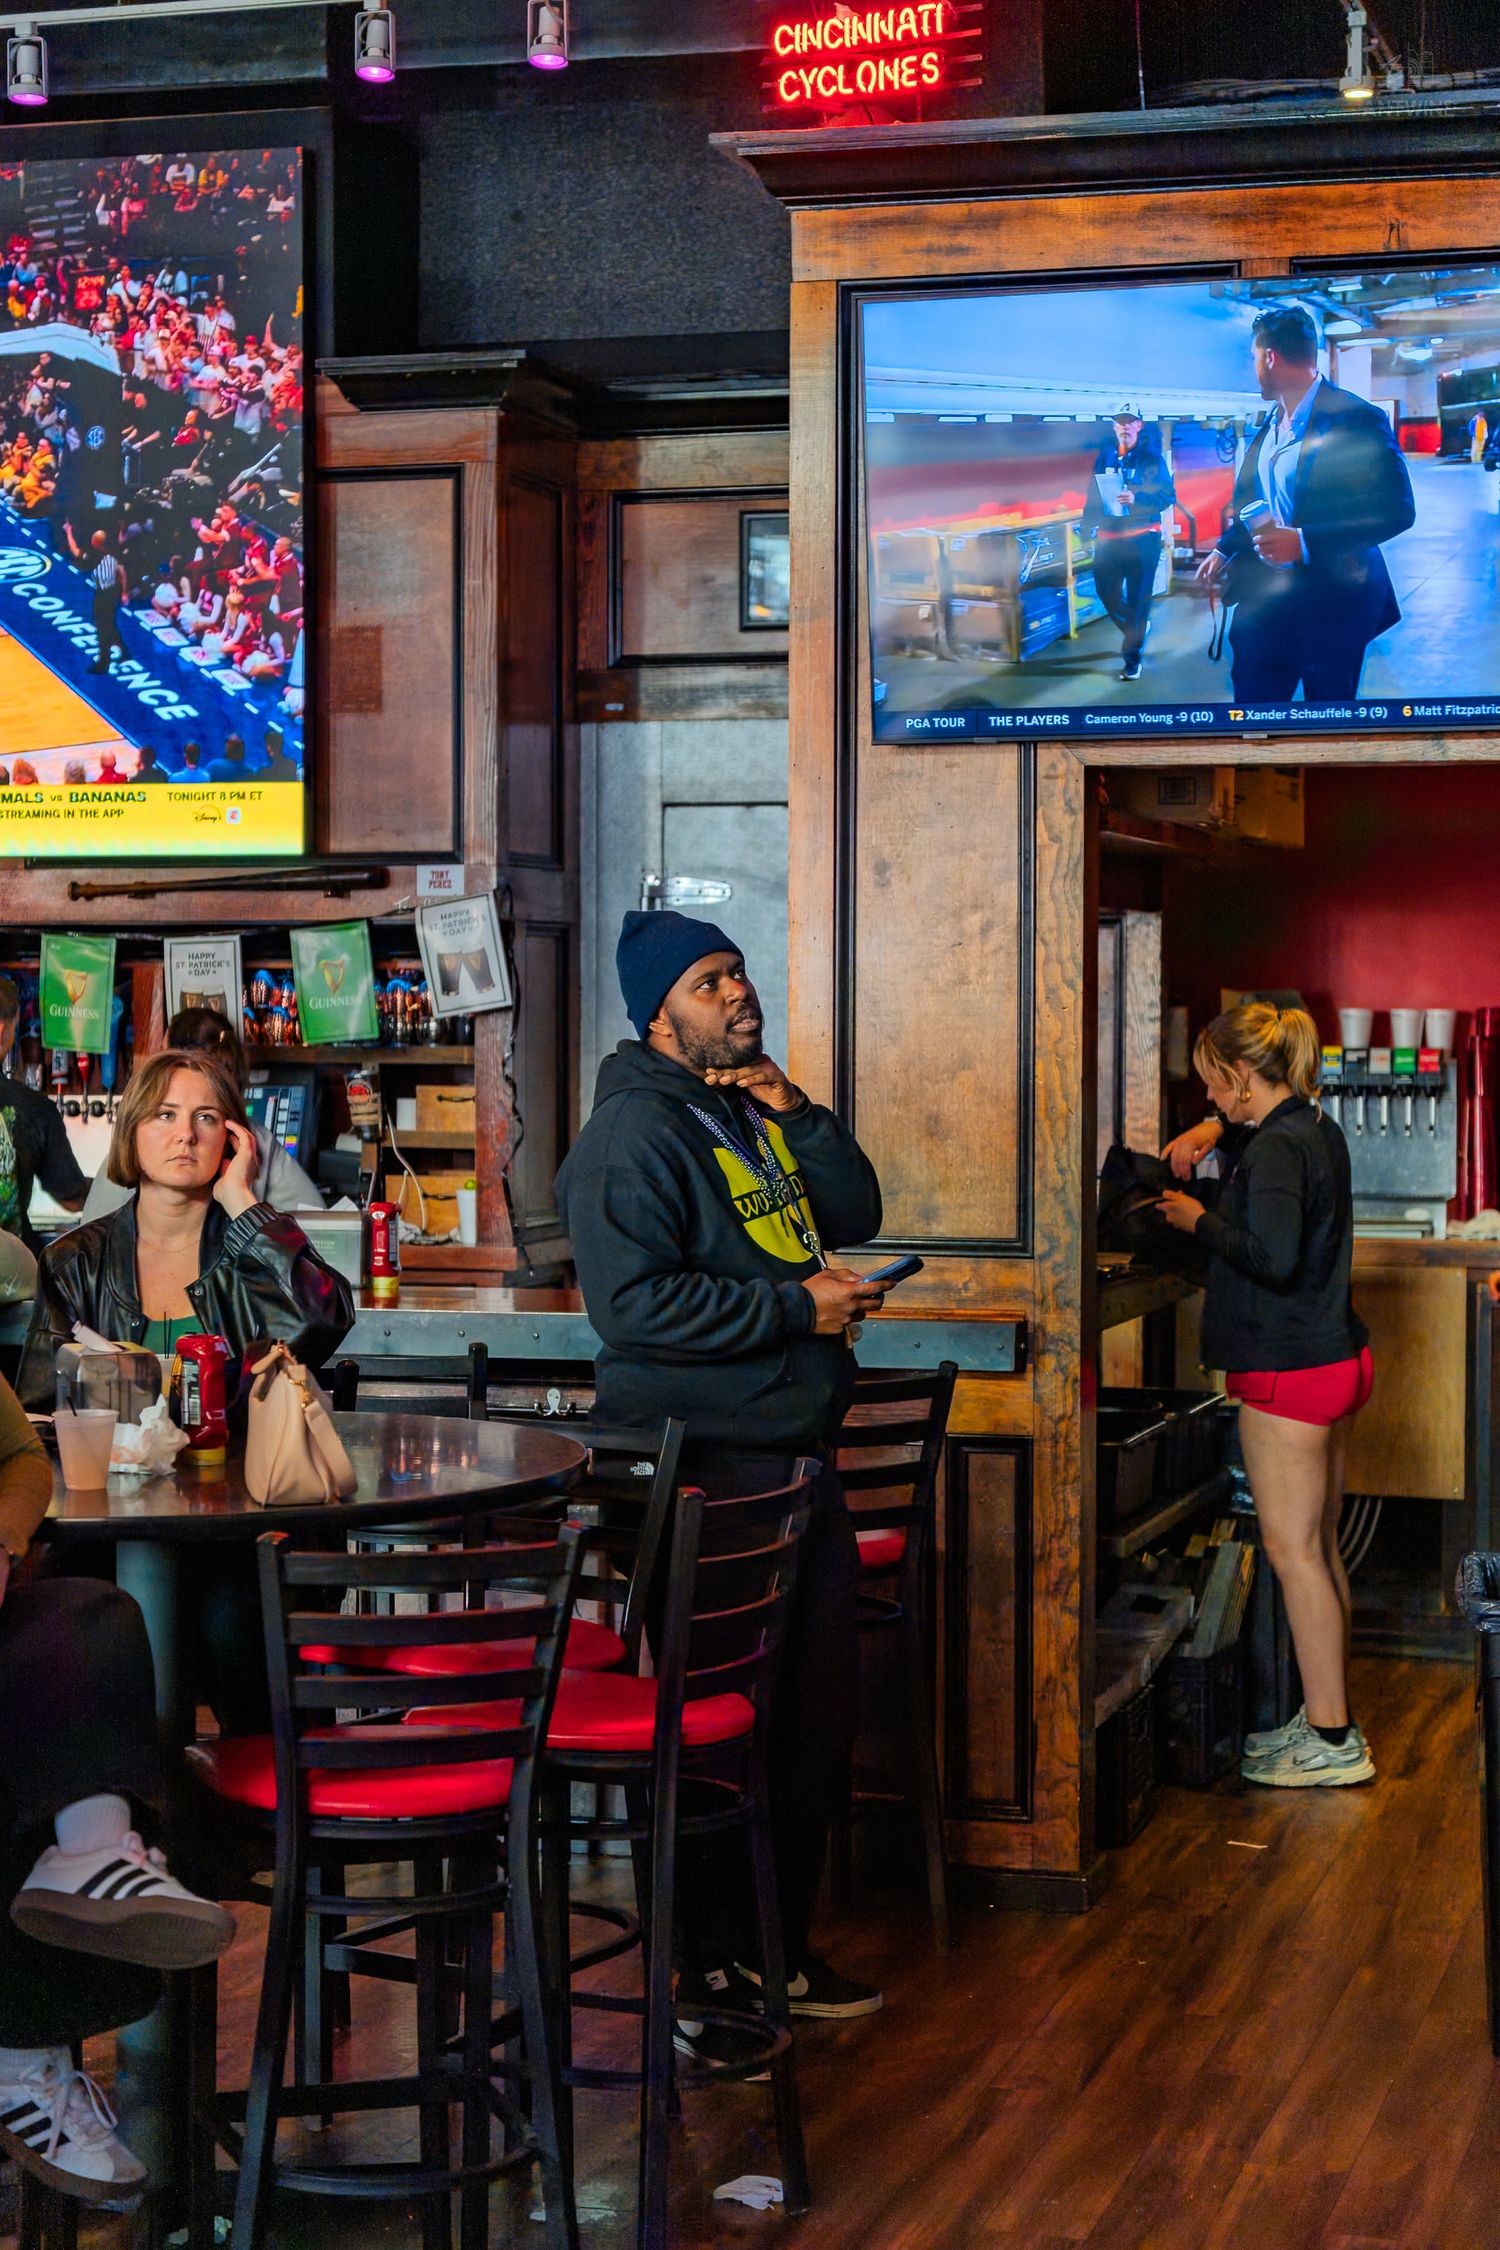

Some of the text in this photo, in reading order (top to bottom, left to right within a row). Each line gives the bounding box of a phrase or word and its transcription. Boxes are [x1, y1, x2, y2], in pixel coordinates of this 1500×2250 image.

[774, 3, 943, 56] CINCINNATI
[779, 52, 940, 102] CYCLONES
[905, 718, 931, 728] PGA
[932, 717, 965, 728] TOUR
[989, 716, 1014, 727] THE
[1016, 714, 1070, 726] PLAYERS
[1085, 713, 1137, 725] Cameron
[1138, 712, 1173, 725] Young
[1176, 712, 1188, 722] -9
[1190, 711, 1214, 723] (10)
[1228, 709, 1245, 721] T2
[1245, 709, 1288, 720] Xander
[1290, 708, 1352, 719] Schauffele
[1354, 707, 1367, 718] -9
[1370, 707, 1388, 719] (9)
[1402, 705, 1412, 717] 6
[1414, 705, 1442, 716] Matt
[69, 792, 147, 802] BANANAS
[167, 791, 216, 802] TONIGHT
[230, 791, 246, 800] PM
[249, 791, 263, 800] ET
[64, 809, 75, 818] IN
[79, 808, 99, 818] THE
[103, 808, 124, 818] APP
[430, 870, 449, 880] TONY
[428, 880, 452, 889] PEREZ
[440, 908, 470, 920] HAPPY
[442, 914, 487, 928] PATRICS
[449, 927, 467, 936] DAY
[188, 952, 216, 960] HAPPY
[189, 960, 230, 969] PATRICK'S
[309, 996, 360, 1009] GUINNE
[49, 1003, 99, 1019] GUINNESS
